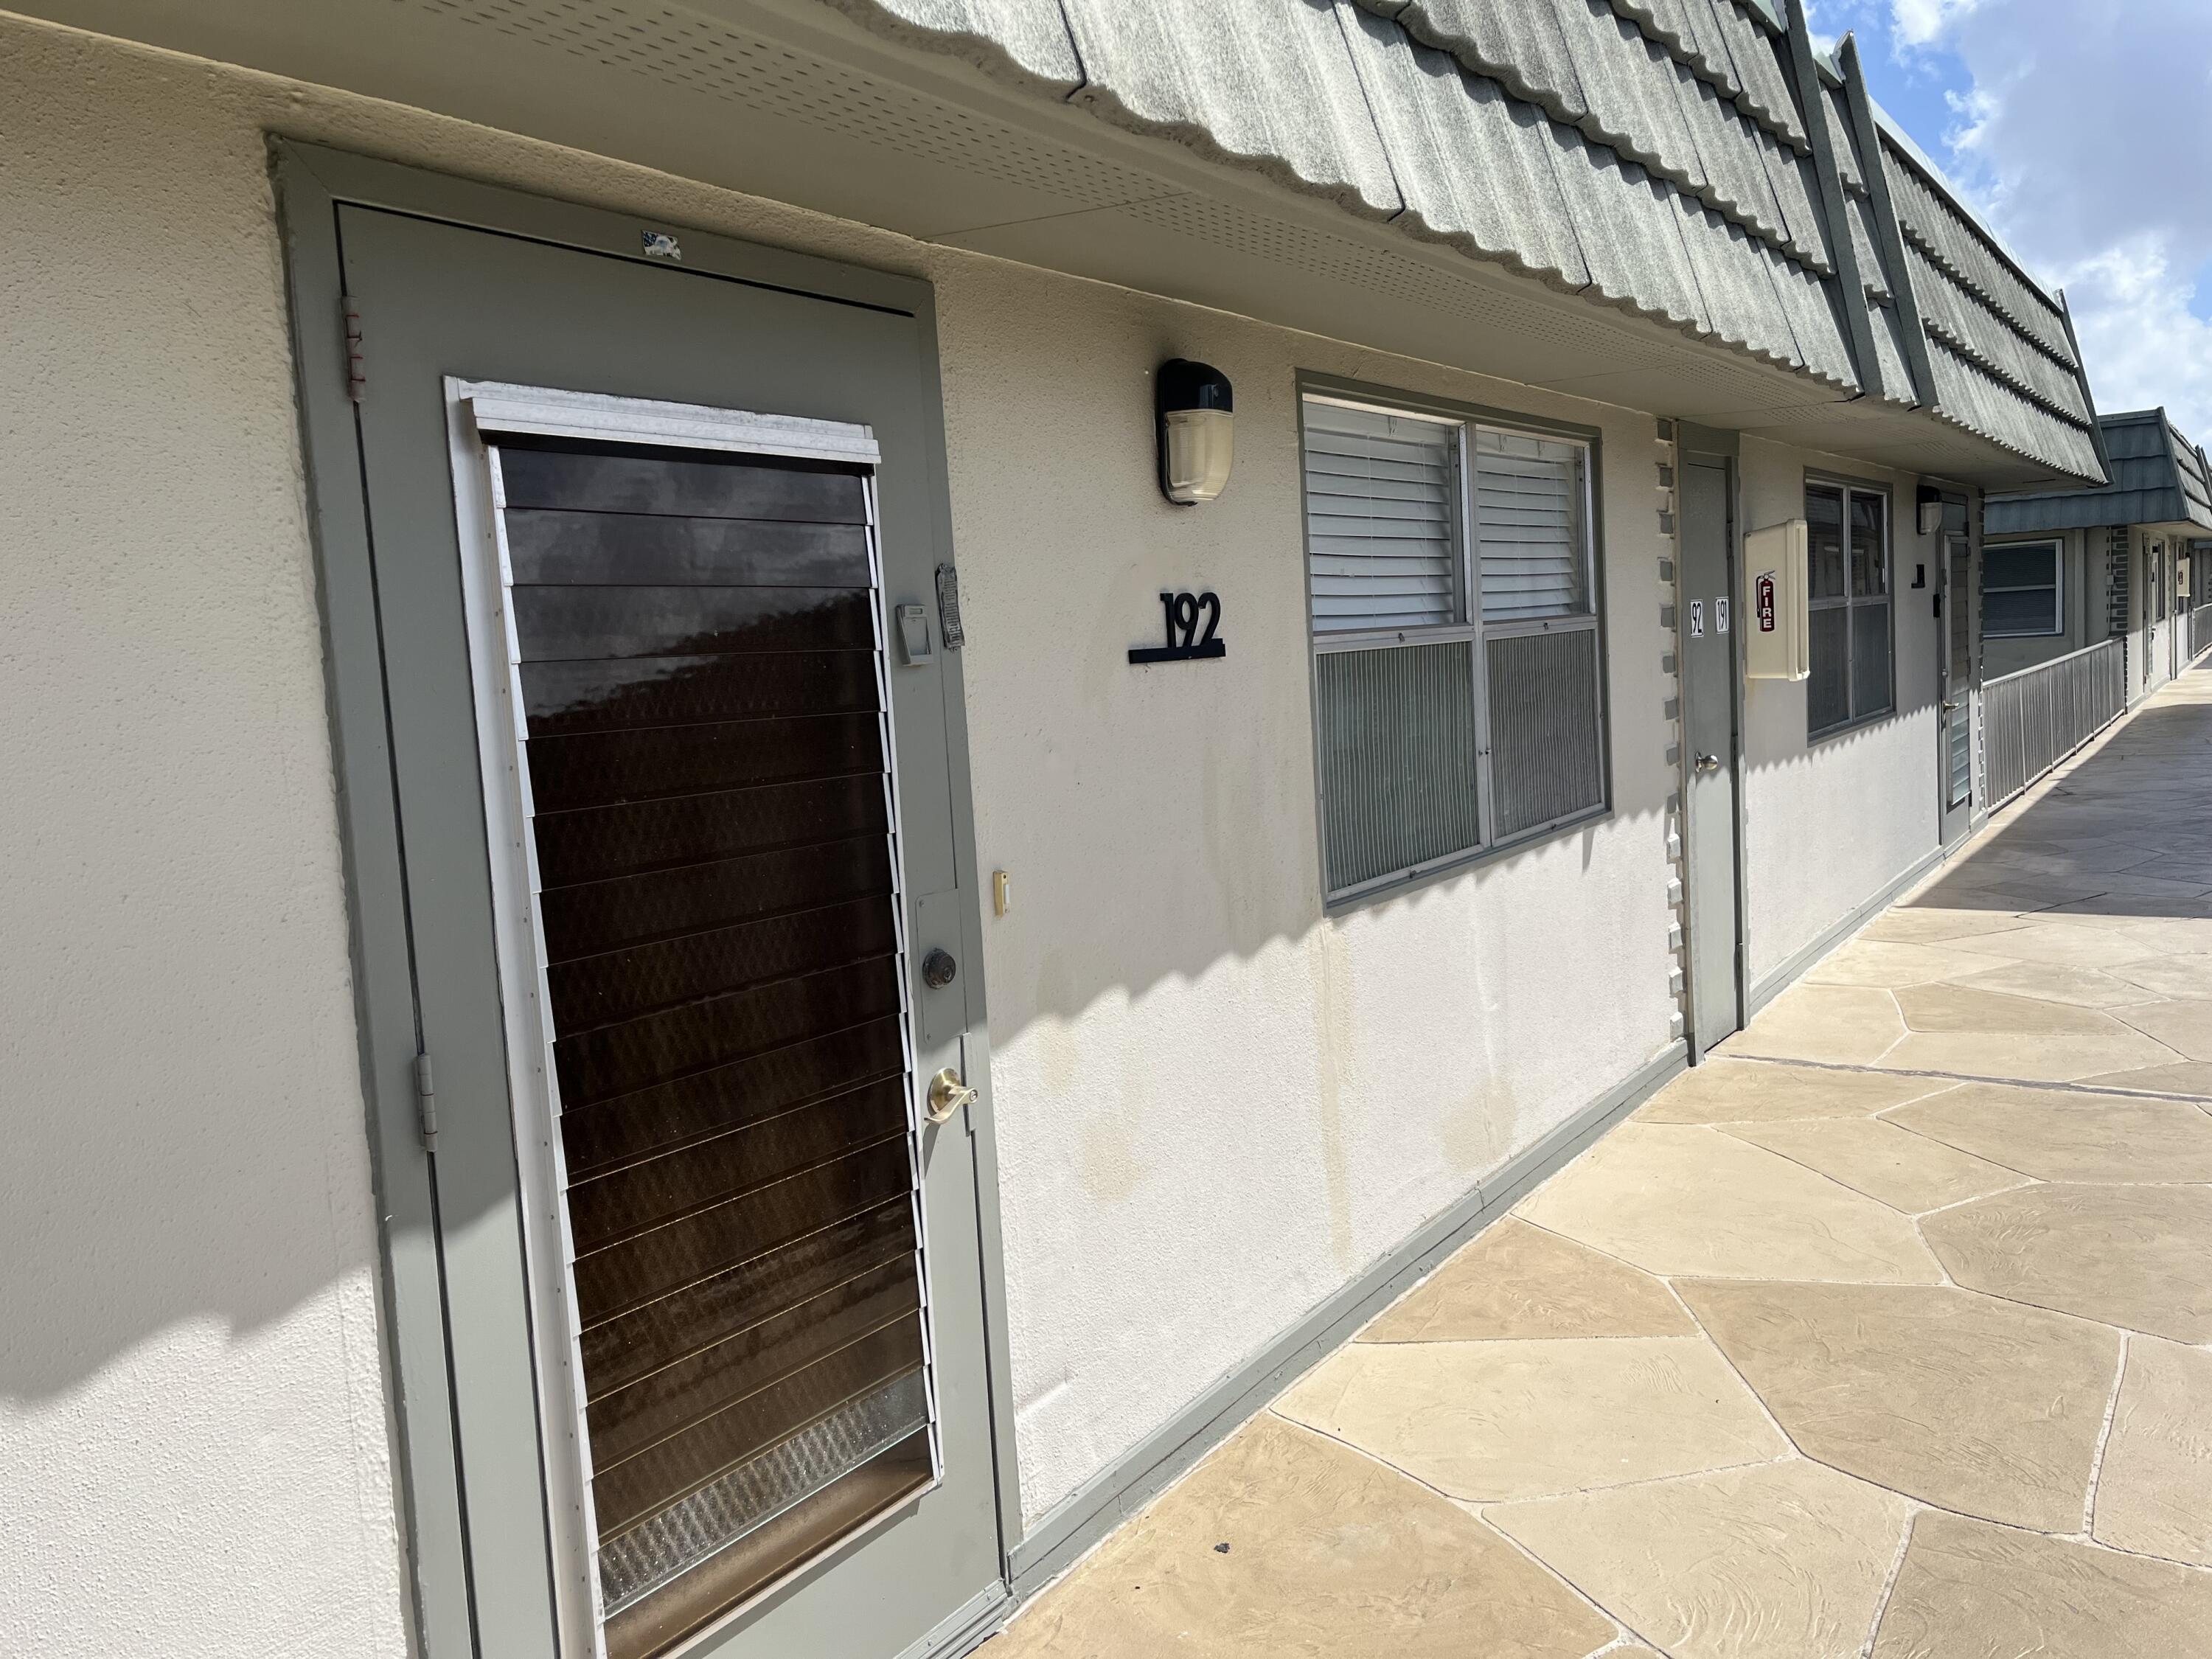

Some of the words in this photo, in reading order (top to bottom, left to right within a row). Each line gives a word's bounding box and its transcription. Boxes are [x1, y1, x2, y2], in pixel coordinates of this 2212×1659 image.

[1159, 592, 1224, 650] 192
[1692, 602, 1702, 634] 92
[1717, 600, 1728, 630] 191
[1762, 585, 1772, 628] FIRE
